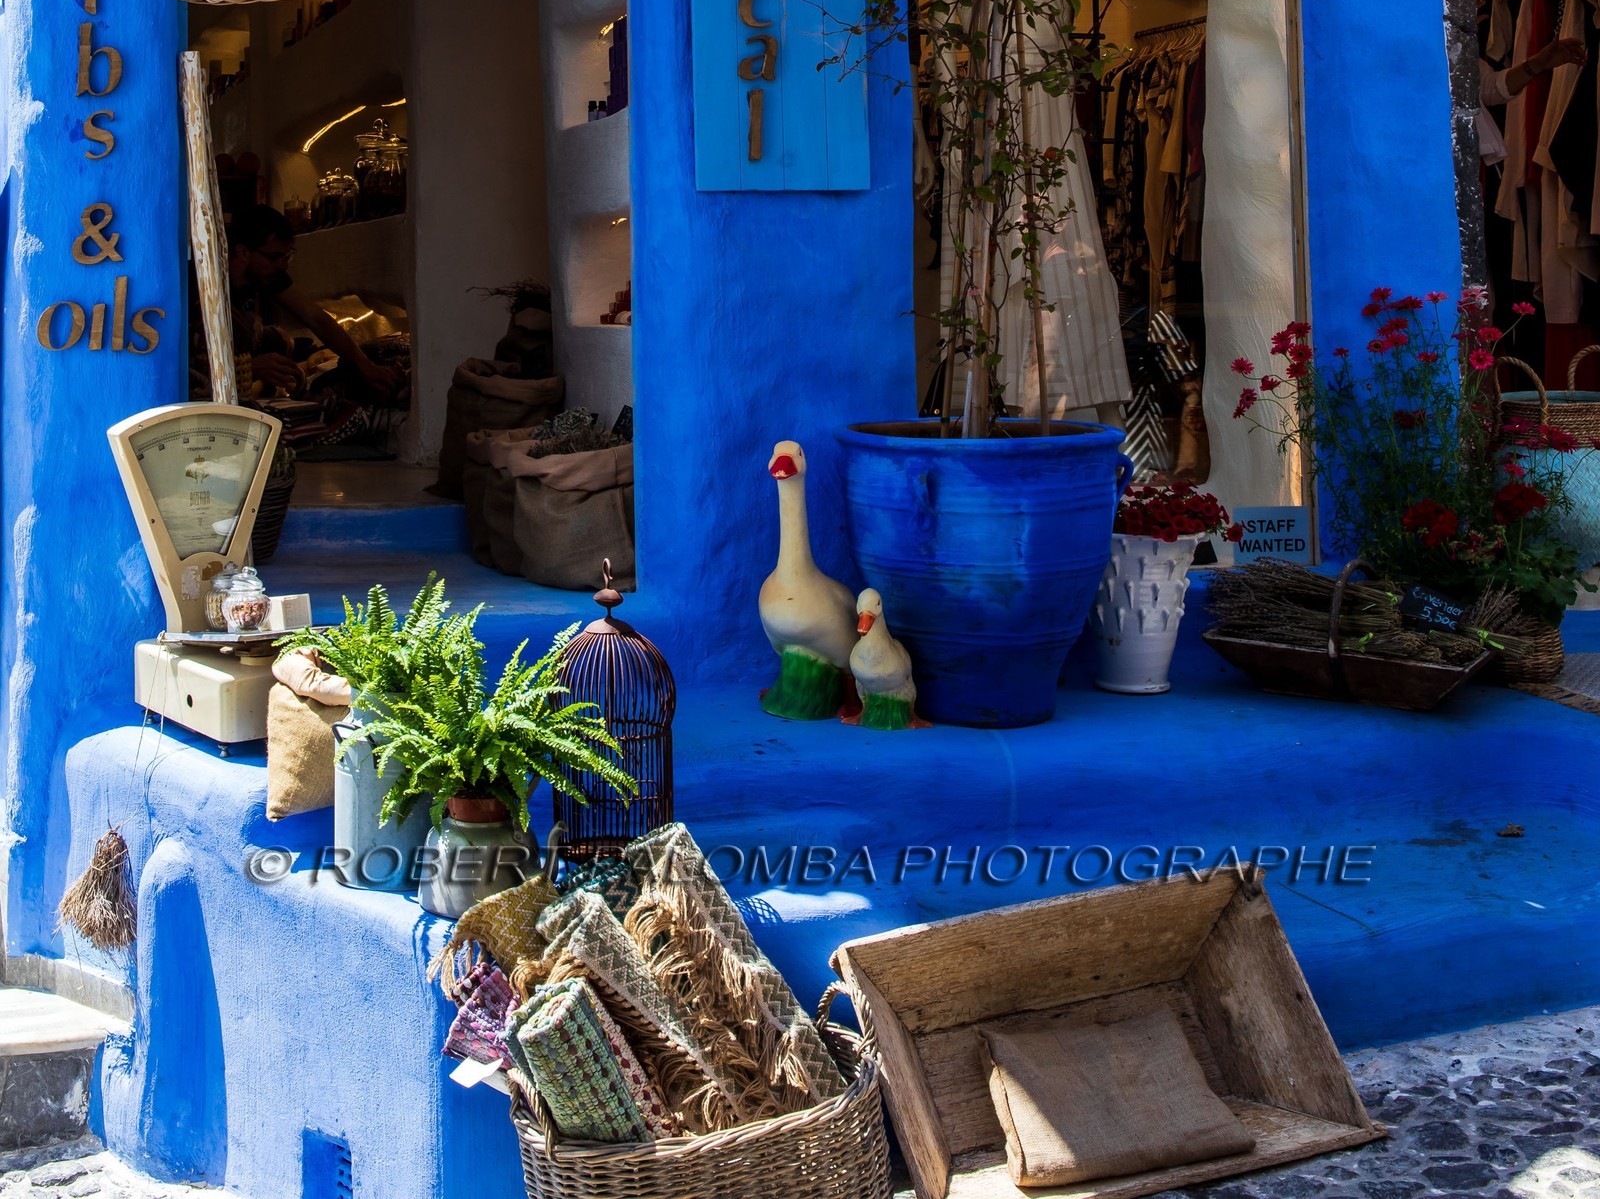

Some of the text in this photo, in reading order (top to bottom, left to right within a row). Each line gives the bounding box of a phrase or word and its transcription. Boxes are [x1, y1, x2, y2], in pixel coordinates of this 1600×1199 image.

[72, 202, 125, 266] &
[36, 275, 167, 355] oils
[1238, 538, 1306, 553] WANTED
[1246, 519, 1296, 534] STAFF
